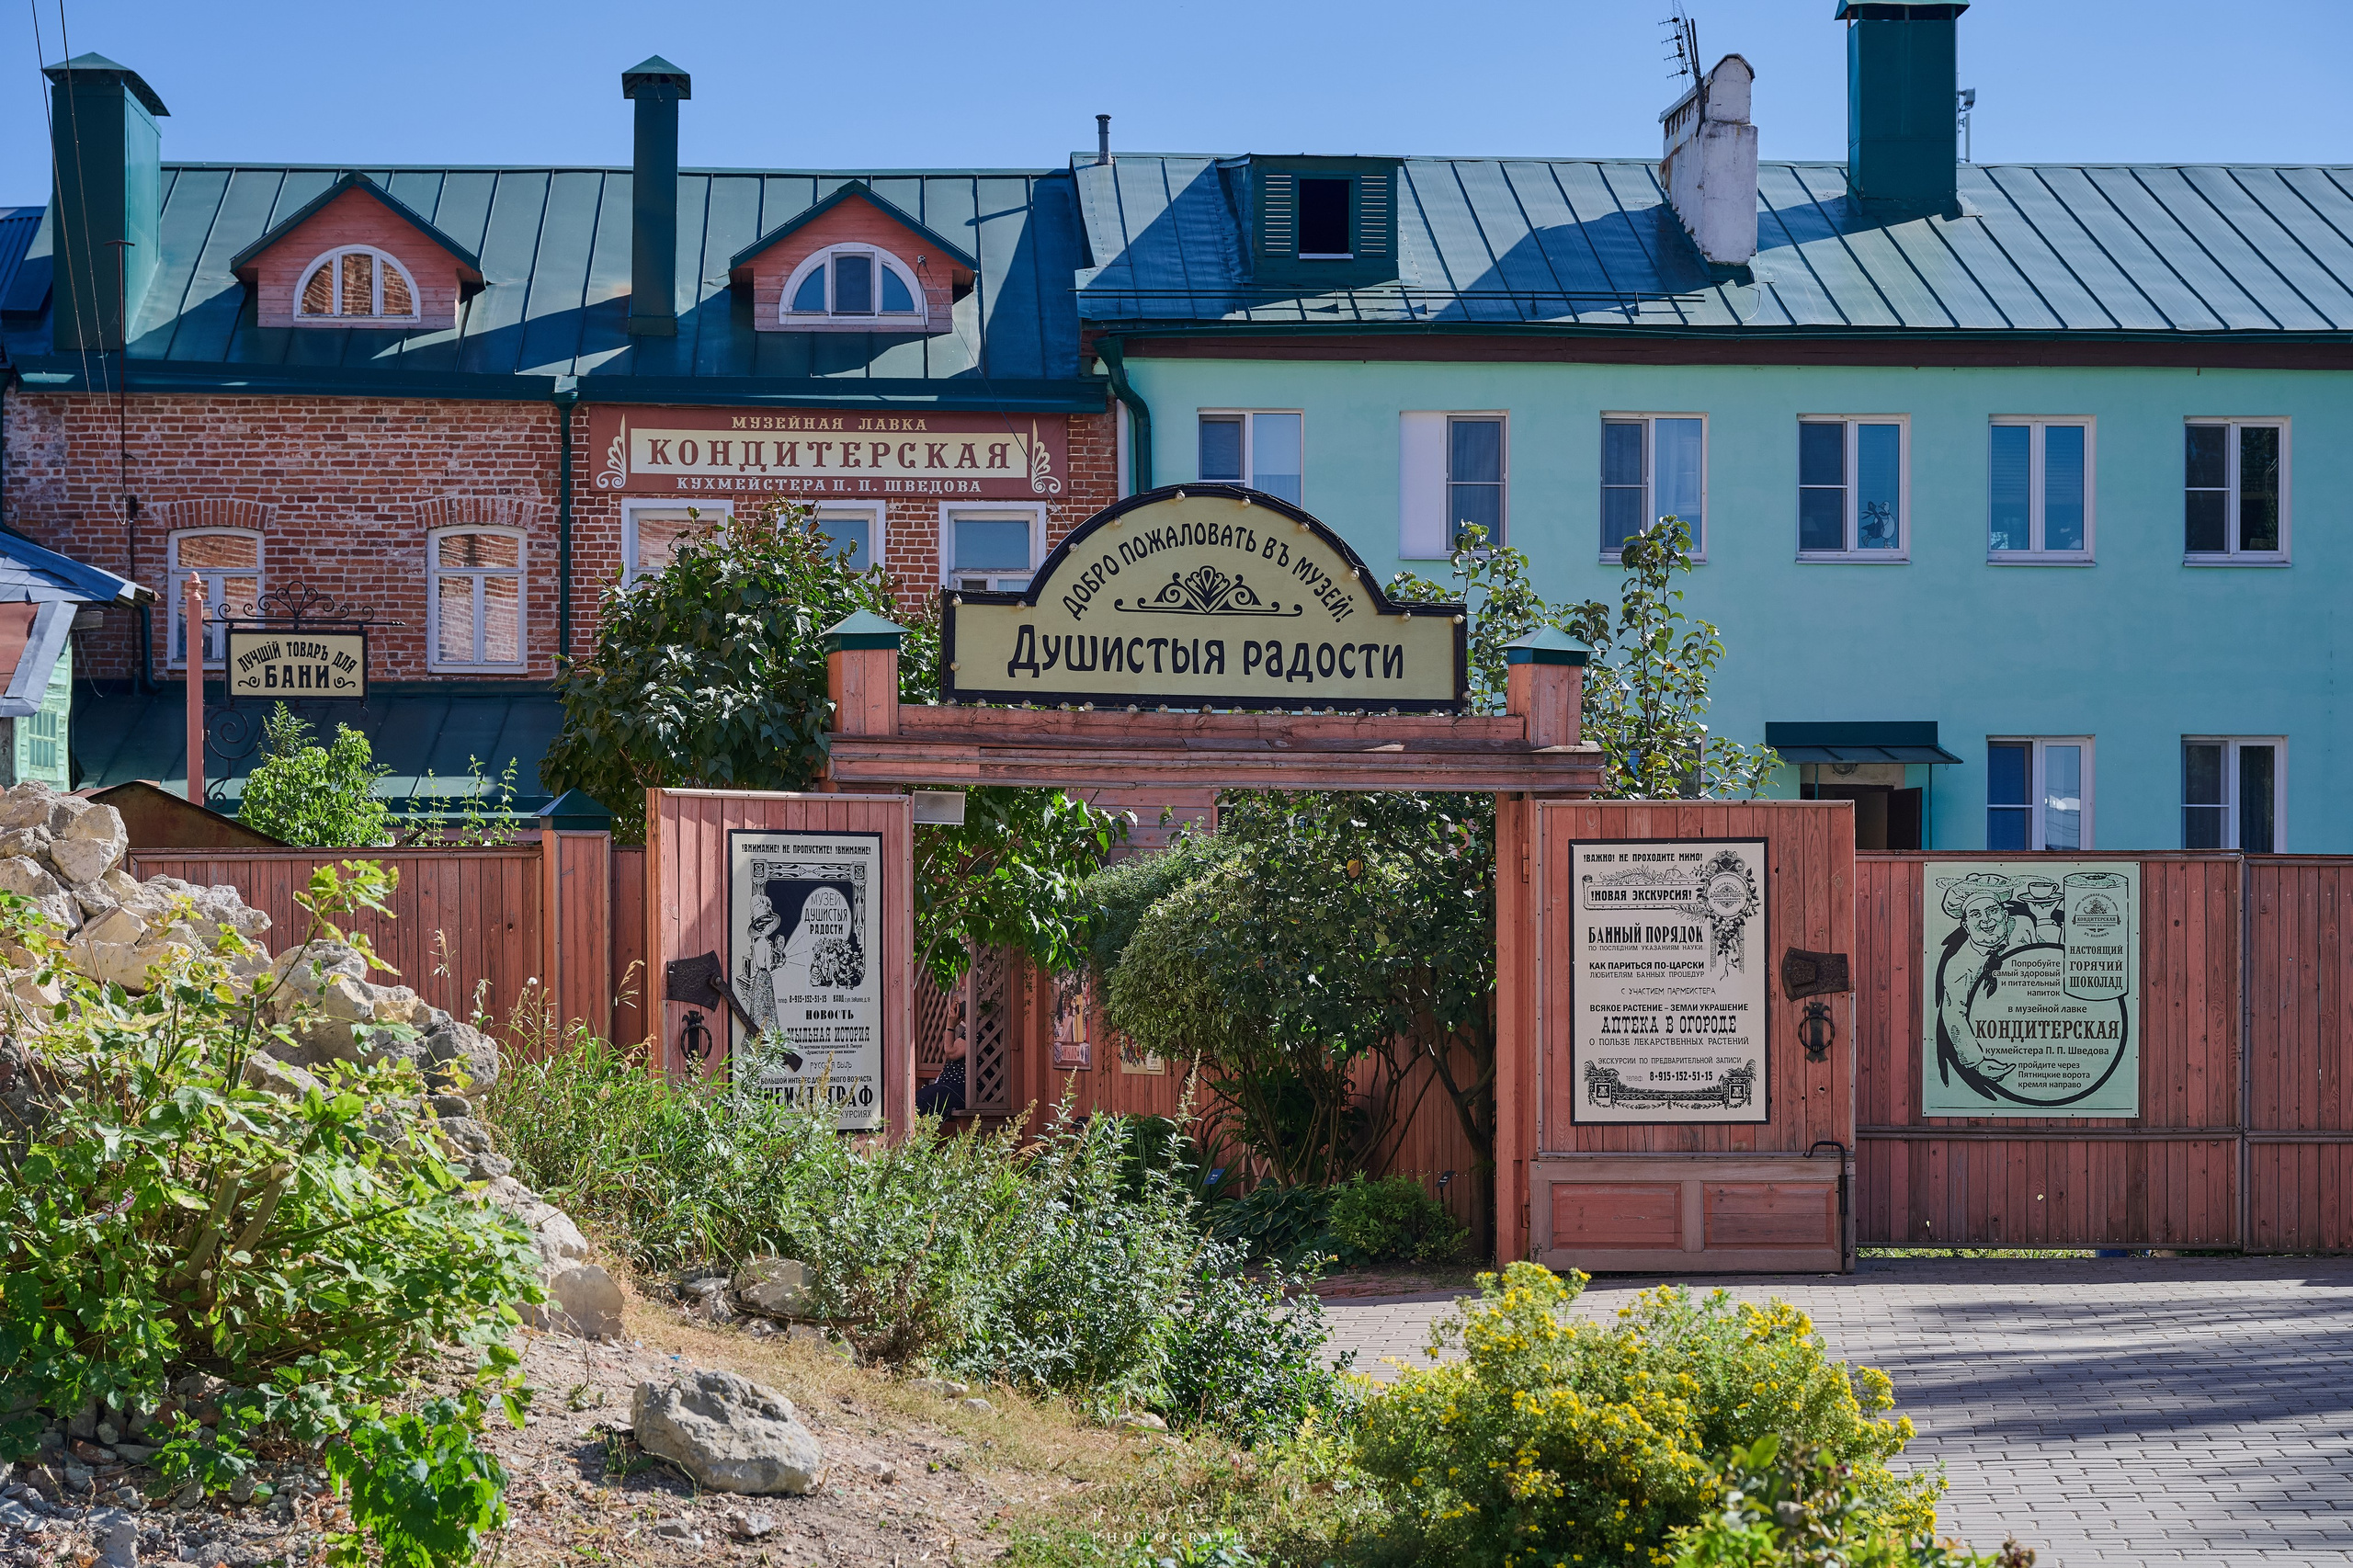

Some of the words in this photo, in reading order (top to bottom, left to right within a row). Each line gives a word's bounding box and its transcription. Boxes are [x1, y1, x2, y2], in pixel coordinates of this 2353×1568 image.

[732, 416, 844, 430] МУЗЕЙНАЯ
[858, 418, 927, 431] ЛАВКА
[647, 439, 1011, 472] КОНДИТЕРСКАЯ
[676, 477, 826, 492] КУХМЕЙСТЕРА
[832, 479, 852, 492] П.
[858, 479, 878, 492] П.
[884, 479, 982, 494] ШВЕДОВА
[1063, 554, 1120, 621] ДОБРО
[1118, 522, 1257, 566] ПОЖАЛОВАТЬ
[1261, 536, 1290, 568] ВЪ
[1291, 556, 1355, 623] МУЗЕЙ!
[286, 642, 329, 662] ТОВАРЪ
[331, 651, 358, 674] ДЛЯ
[265, 665, 330, 688] БАНИ
[742, 844, 779, 854] !ВНИМАНИЕ!
[782, 845, 790, 854] НЕ
[792, 845, 833, 855] ПРОПУСТИТЕ!
[835, 846, 871, 856] !ВНИМАНИЕ!
[1583, 853, 1615, 863] !ВАЖНО!
[1619, 854, 1629, 862] НЕ
[1632, 853, 1676, 863] ПРОХОДИТЕ
[1678, 852, 1703, 862] МИМО!
[811, 892, 841, 906] МУЗЕЙ
[1590, 890, 1627, 902] !НОВАЯ
[1632, 890, 1692, 902] ЭКСКУРСИЯ!
[804, 908, 847, 923] ДУШИСТЫЯ
[810, 924, 844, 936] РАДОСТИ
[1588, 922, 1642, 943] БАННЫЙ
[1645, 926, 1703, 944] ПОРЯДОК
[2069, 945, 2123, 956] НАСТОЯЩИЙ
[1589, 961, 1607, 970] КАК
[1608, 961, 1653, 970] ПАРИТЬСЯ
[1654, 961, 1704, 971] ПО-ЦАРСКИ
[2011, 959, 2061, 968] Попробуйте
[2069, 960, 2123, 971] ГОРЯЧИЙ
[1636, 971, 1665, 979] БАННЫХ
[1668, 971, 1705, 979] ПРОЦЕДУР
[1992, 969, 2018, 977] самый
[2020, 969, 2061, 979] здоровый
[2007, 979, 2061, 987] питательный
[2069, 976, 2123, 990] ШОКОЛАД
[833, 994, 845, 1003] ВХОД
[1670, 1004, 1699, 1012] ЗЕМЛИ
[2015, 1005, 2059, 1014] музейной
[805, 1009, 855, 1020] НОВОСТЬ
[1601, 1016, 1659, 1034] АПТЕКА
[1665, 1015, 1674, 1034] В
[1679, 1015, 1737, 1035] ОГОРОДЕ
[835, 1027, 870, 1042] ИСТОРИЯ
[1975, 1020, 2120, 1042] КОНДИТЕРСКАЯ
[1598, 1038, 1630, 1046] ПОЛЬЗЕ
[1633, 1038, 1703, 1046] ЛЕКАРСТВЕННЫХ
[1708, 1036, 1749, 1045] РАСТЕНИЙ
[1985, 1046, 2043, 1056] кухмейстера
[2046, 1047, 2055, 1055] П.
[2057, 1047, 2066, 1055] П.
[2068, 1047, 2109, 1056] Шведова
[1651, 1056, 1713, 1065] ПРЕДВАРИТЕЛЬНОЙ
[2018, 1061, 2056, 1070] пройдите
[810, 1061, 835, 1074] РУССЯ
[788, 1076, 811, 1085] ИНТЕЕС
[2018, 1071, 2061, 1080] Пятницкие
